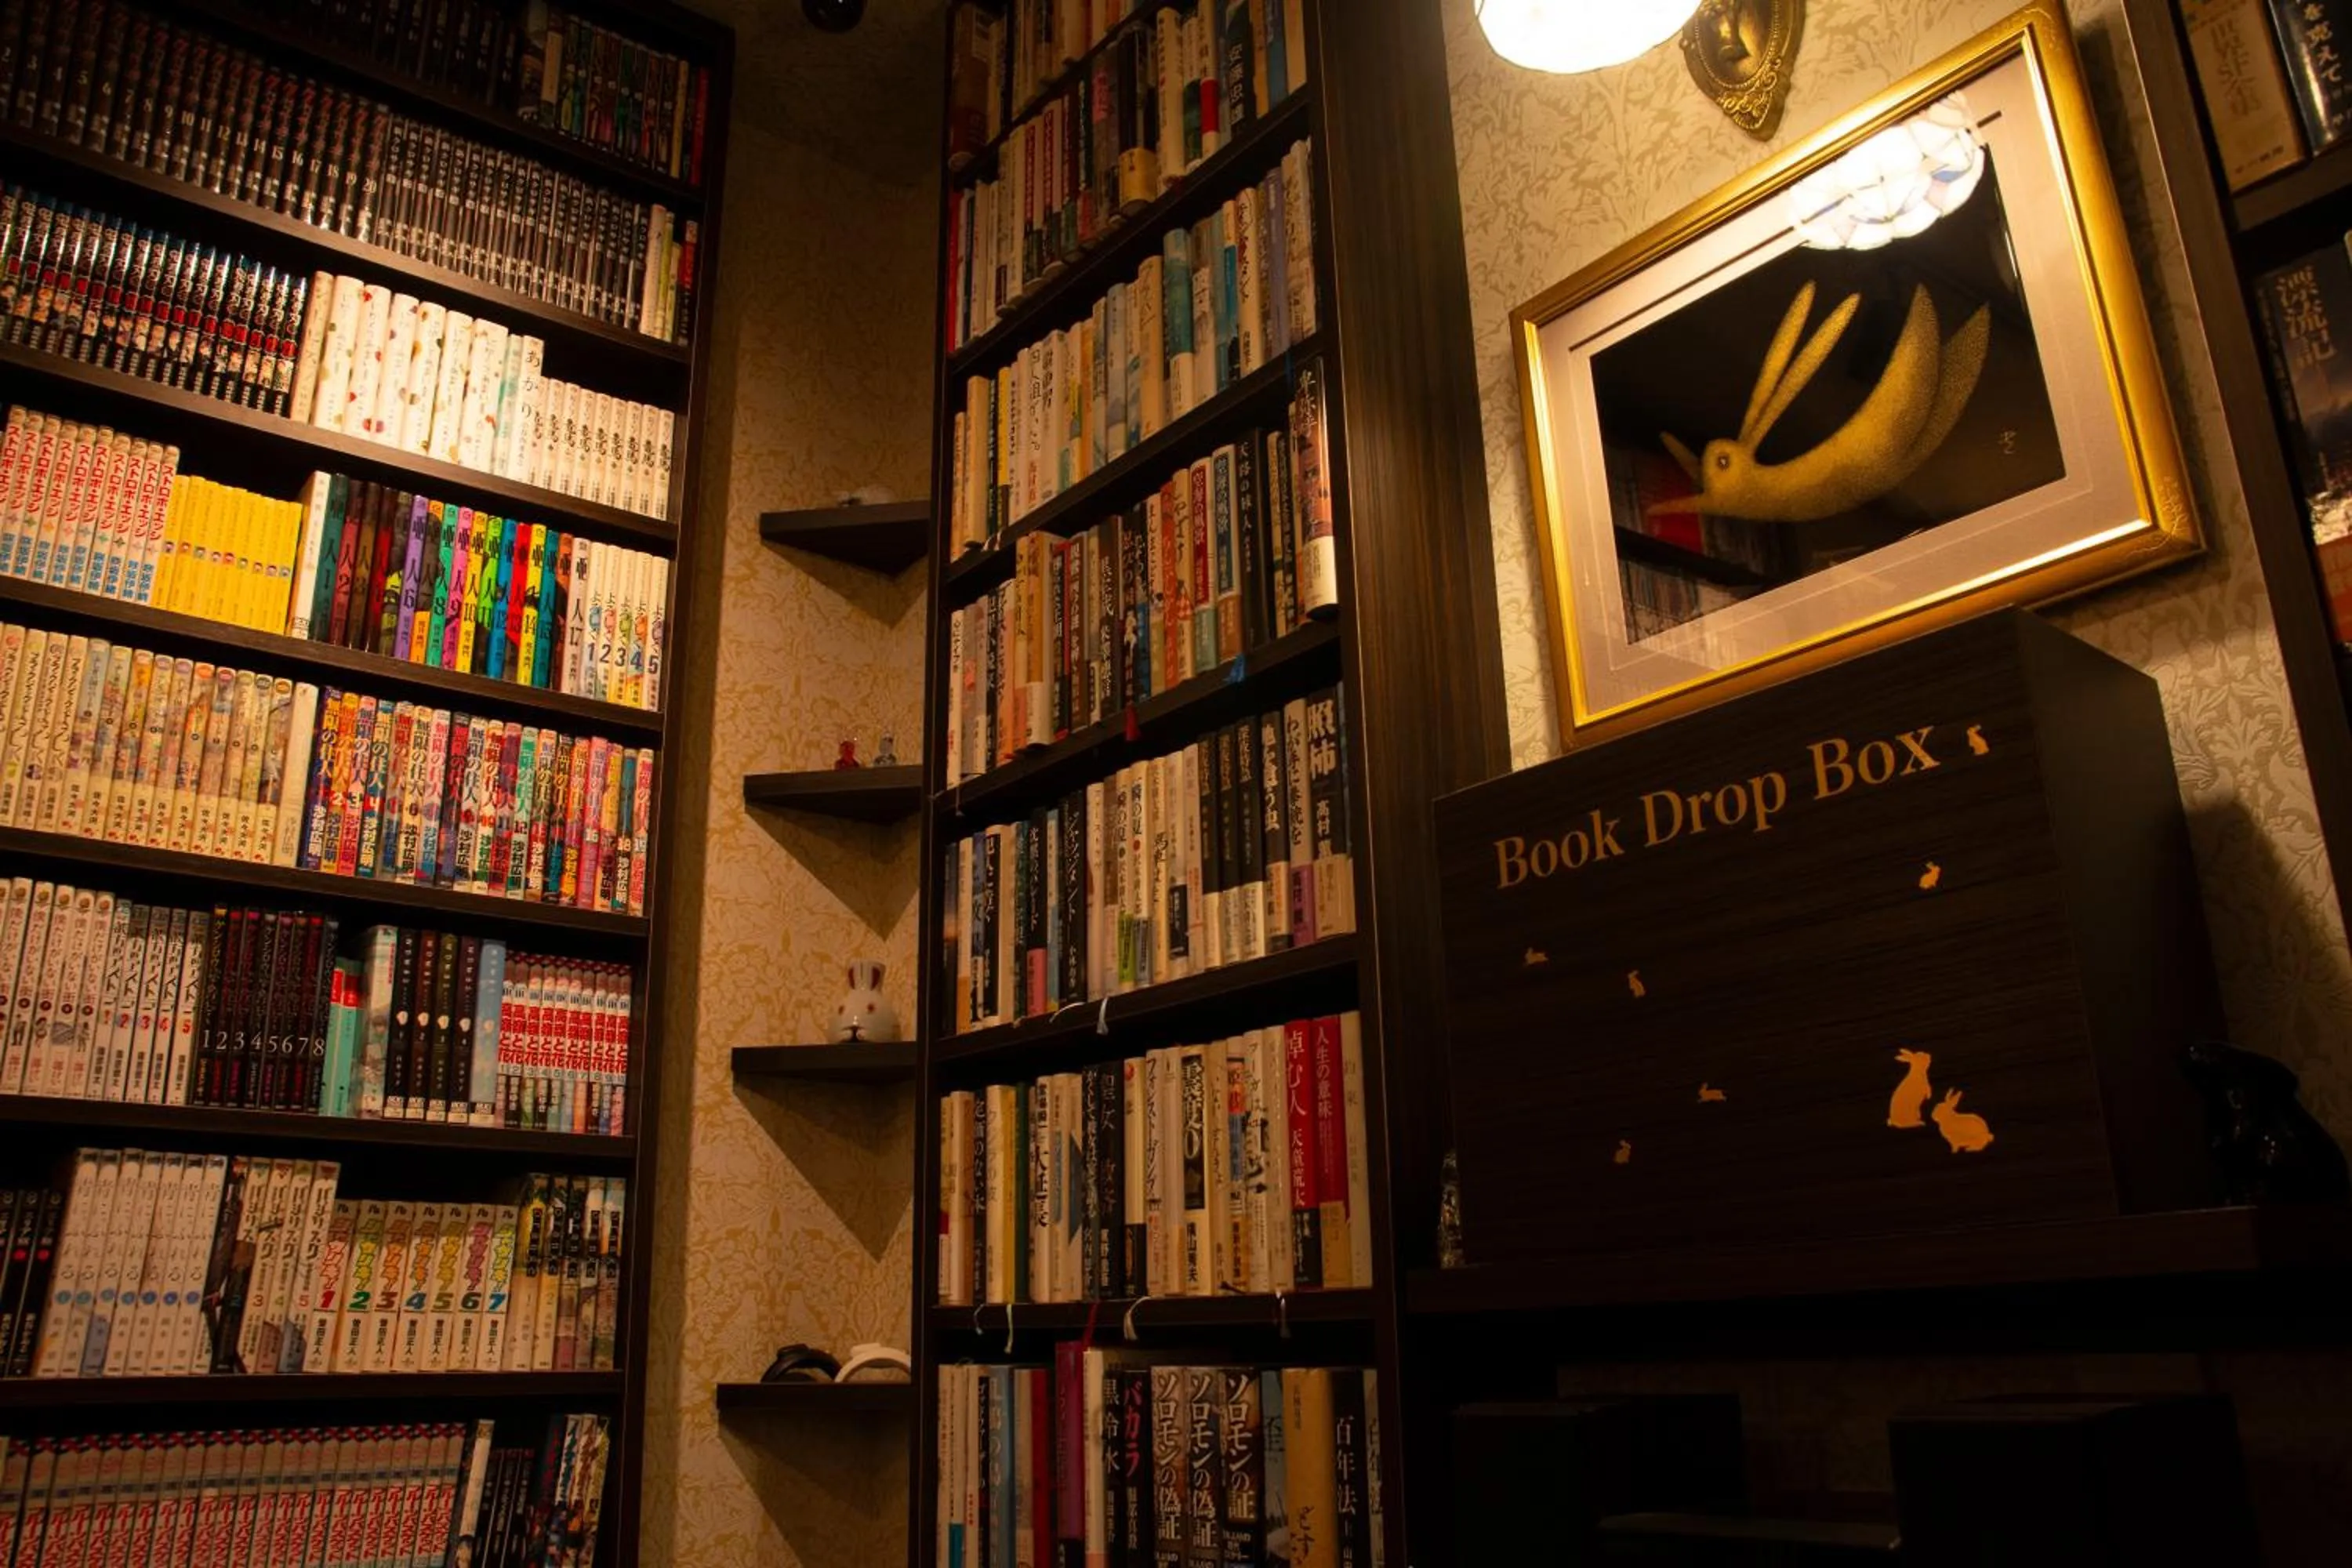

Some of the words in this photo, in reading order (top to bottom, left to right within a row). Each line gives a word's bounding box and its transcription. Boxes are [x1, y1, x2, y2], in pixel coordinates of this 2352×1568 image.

[78, 71, 88, 85] 5
[102, 81, 111, 96] 6
[125, 89, 134, 104] 7
[165, 105, 173, 118] 9
[182, 111, 195, 125] 10
[200, 118, 212, 133] 11
[218, 125, 230, 141] 12
[253, 138, 266, 153] 14
[271, 145, 283, 160] 15
[292, 151, 303, 166] 16
[310, 158, 322, 174] 17
[327, 164, 339, 178] 18
[345, 172, 357, 186] 19
[363, 179, 376, 194] 20
[2276, 265, 2337, 368] 漂流記
[11, 433, 37, 510] ストロボ・エッジ
[27, 436, 53, 513] ストロボ・エッジ
[46, 441, 72, 517] ストロボ・エッジ
[65, 445, 92, 521] ストロボ・エッジ
[82, 447, 107, 523] ストロボ・エッジ
[100, 454, 126, 529] ストロボ・エッジ
[117, 458, 143, 536] ストロボ・エッジ
[135, 463, 158, 537] ストロボ・エッジ
[151, 465, 174, 540] ストロボ・エッジ
[404, 590, 414, 609] 6
[435, 595, 445, 615] 8
[448, 597, 460, 618] 9
[571, 626, 583, 646] 17
[588, 643, 596, 661] 1
[600, 644, 611, 664] 2
[615, 648, 626, 666] 3
[630, 650, 642, 670] 4
[648, 655, 659, 674] 5
[1307, 699, 1337, 779] 照柿
[409, 721, 430, 796] 無限の住人
[465, 728, 483, 803] 無限の住人
[349, 793, 361, 809] 3
[1494, 810, 1625, 890] Book
[1640, 771, 1788, 847] Drop
[1806, 724, 1941, 800] Box
[203, 1030, 210, 1048] 1
[216, 1031, 227, 1050] 2
[234, 1030, 245, 1049] 3
[251, 1032, 262, 1050] 4
[268, 1036, 278, 1052] 5
[281, 1035, 294, 1053] 6
[297, 1037, 308, 1055] 7
[313, 1039, 324, 1055] 8
[1316, 1027, 1334, 1117] 人生の意味
[281, 1186, 309, 1259] バジリスク
[307, 1188, 330, 1259] バジリスク
[253, 1295, 263, 1306] 3
[299, 1294, 309, 1306] 5
[321, 1292, 335, 1308] 1
[349, 1293, 370, 1308] 2
[377, 1293, 398, 1307] 3
[406, 1293, 426, 1308] 4
[434, 1293, 453, 1309] 5
[462, 1293, 481, 1308] 6
[488, 1293, 506, 1312] 7
[1157, 1373, 1181, 1541] ソロモンの偽証
[1190, 1374, 1217, 1548] ソロモンの偽証
[1336, 1414, 1357, 1515] 百年法
